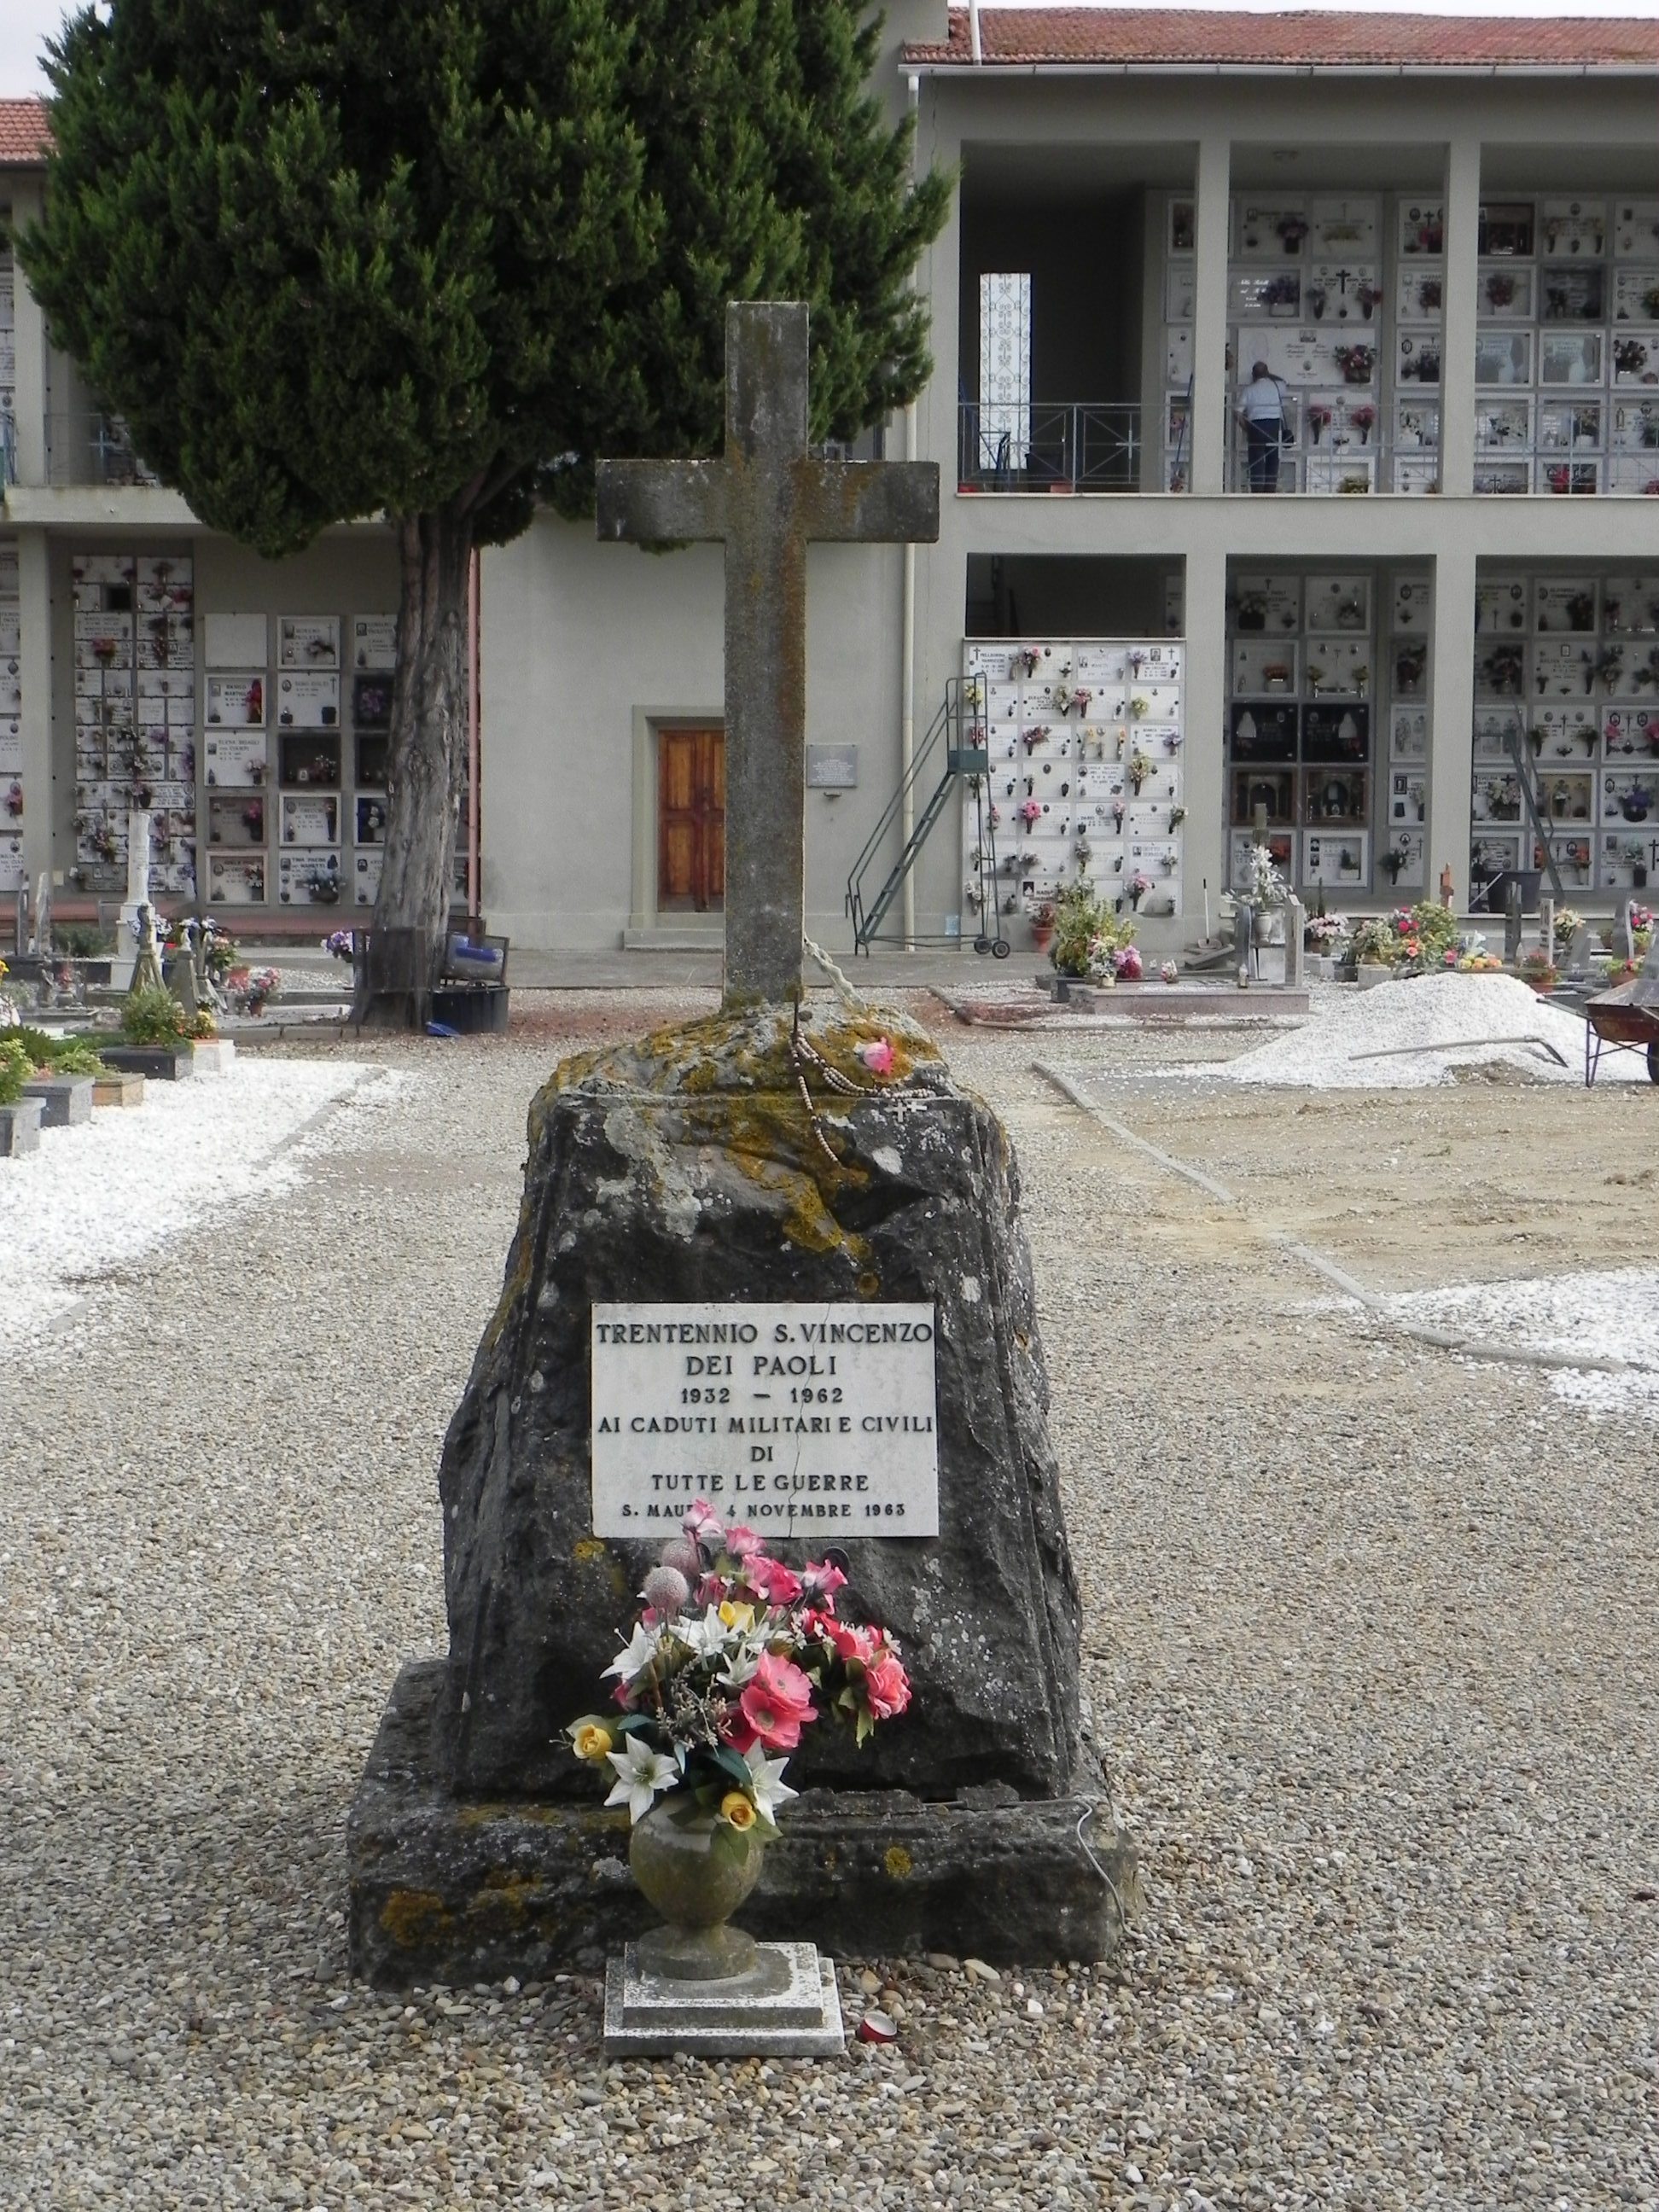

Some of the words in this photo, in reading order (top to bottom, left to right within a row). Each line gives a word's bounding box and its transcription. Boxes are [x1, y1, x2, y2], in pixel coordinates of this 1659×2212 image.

[596, 1324, 759, 1345] TRENTENNIO
[802, 1324, 932, 1344] VINCENZO
[686, 1355, 733, 1377] DEI
[754, 1355, 836, 1376] PAOLI
[681, 1388, 731, 1405] 1932
[790, 1388, 843, 1404] 1962
[597, 1417, 620, 1434] AI
[630, 1417, 717, 1434] CADUTI
[728, 1417, 830, 1434] MILITARI
[838, 1417, 852, 1434] E
[861, 1416, 932, 1434] CIVILI
[750, 1446, 774, 1463] DI
[651, 1475, 724, 1492] TUTTE
[735, 1475, 765, 1492] LE
[773, 1475, 869, 1492] GUERRE
[621, 1505, 638, 1517] S.
[726, 1505, 736, 1518] 4
[748, 1505, 852, 1517] NOVEMBRE
[865, 1504, 905, 1517] 1963
